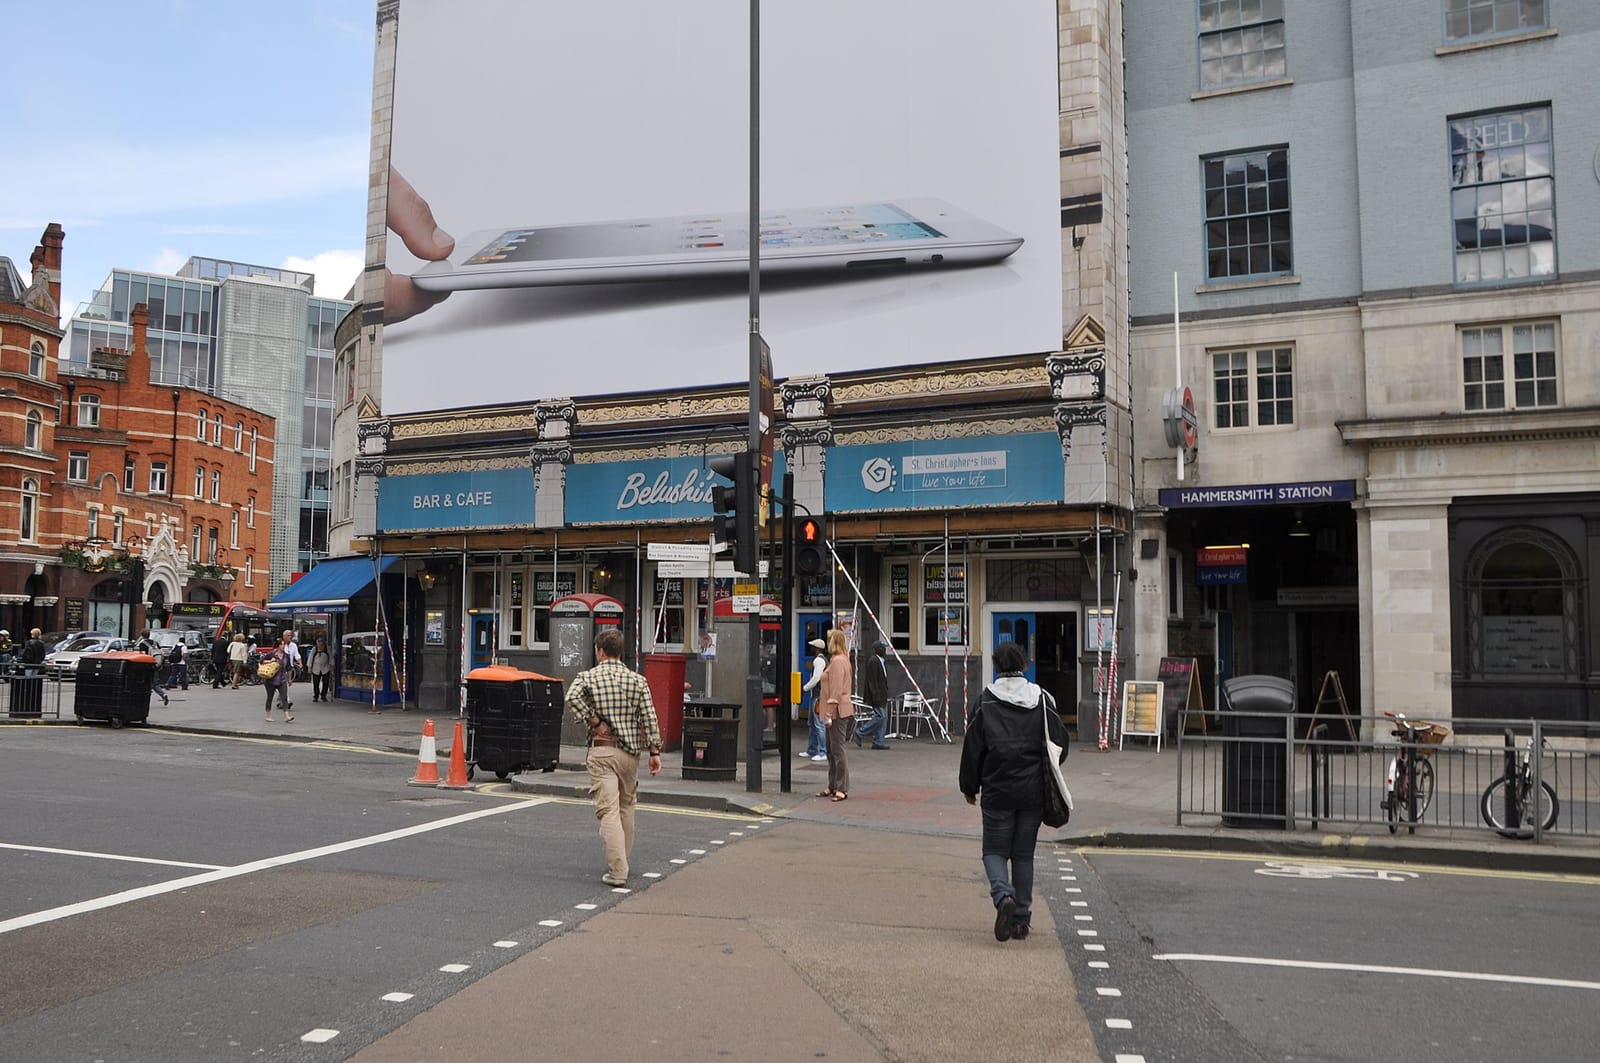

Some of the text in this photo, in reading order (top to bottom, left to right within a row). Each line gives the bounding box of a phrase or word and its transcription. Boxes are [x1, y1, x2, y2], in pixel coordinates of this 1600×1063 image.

[1466, 122, 1530, 149] REED
[925, 456, 978, 470] Christopher's
[980, 455, 997, 466] Inns
[968, 471, 986, 488] life
[413, 491, 492, 509] BAR & CAFE
[1181, 485, 1333, 503] HAMMERSMITH STATION
[700, 588, 730, 600] sprts
